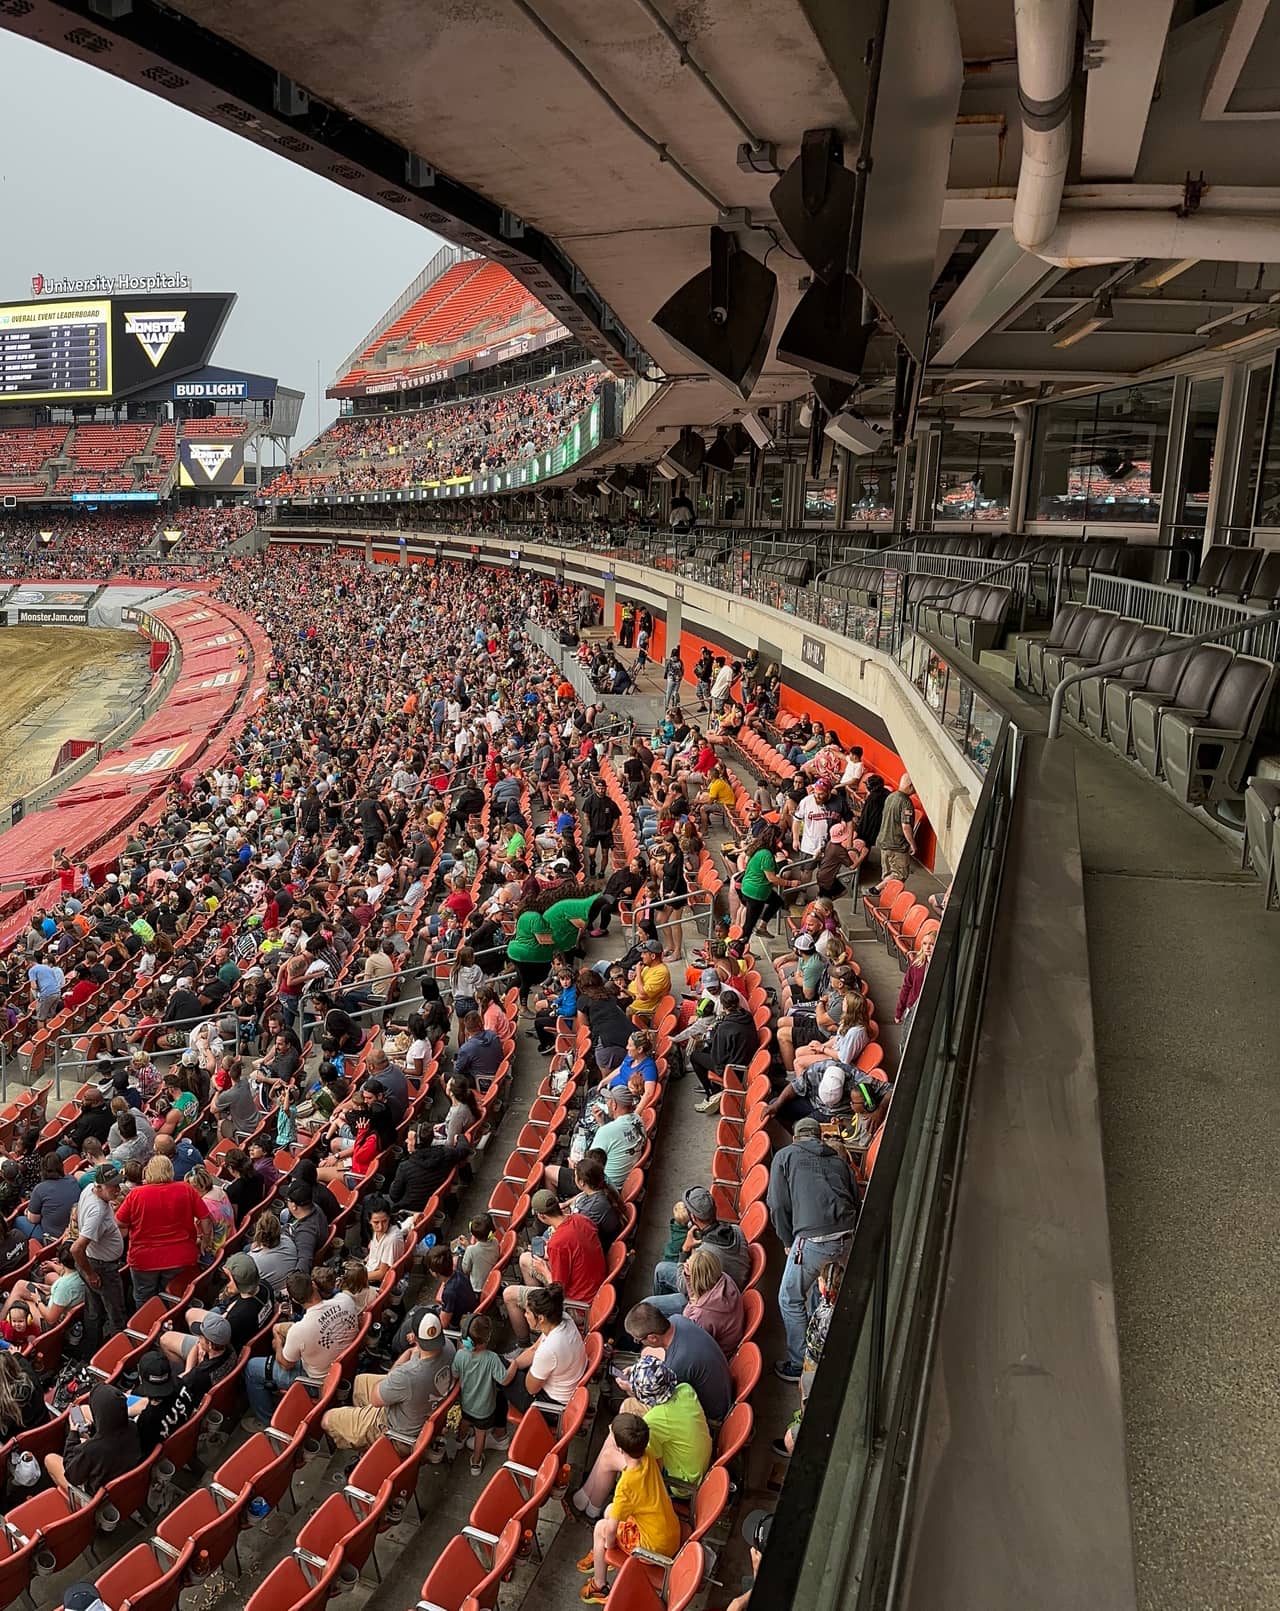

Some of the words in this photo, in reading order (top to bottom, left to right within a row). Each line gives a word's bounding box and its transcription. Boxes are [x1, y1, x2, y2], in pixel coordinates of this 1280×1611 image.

[44, 275, 115, 294] University
[118, 271, 188, 292] Hospitals
[11, 314, 37, 323] OVERALL
[38, 312, 56, 321] EVENT
[57, 310, 100, 319] LEADERBOARD
[125, 321, 185, 333] MONSTER
[141, 333, 171, 344] JAM
[177, 384, 205, 396] BUD
[205, 384, 245, 396] LIGHT
[21, 612, 87, 622] MonsterJam.com
